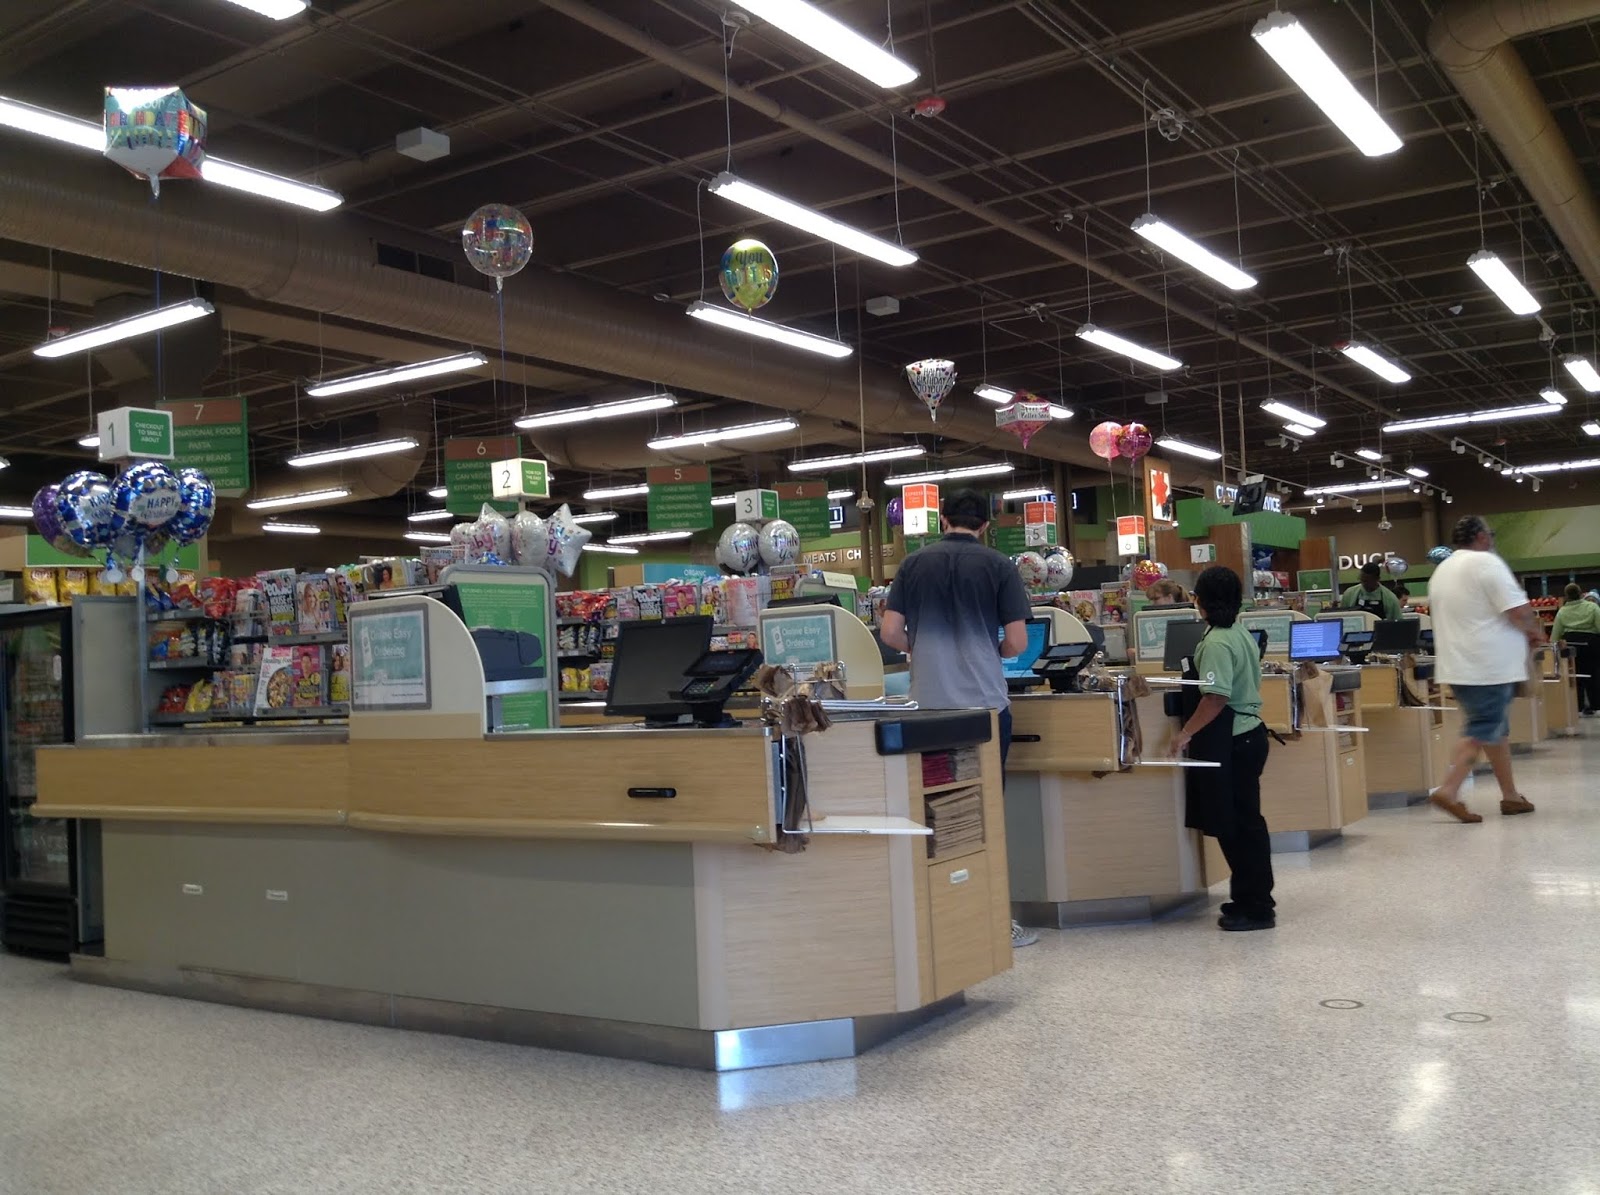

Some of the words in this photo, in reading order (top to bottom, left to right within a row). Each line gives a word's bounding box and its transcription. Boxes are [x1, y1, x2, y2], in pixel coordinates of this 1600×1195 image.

[194, 404, 204, 420] 7
[135, 422, 165, 430] CHECKOUT
[215, 427, 241, 435] FOODS
[108, 422, 115, 446] 1
[477, 442, 487, 455] 6
[205, 453, 231, 462] BEANS
[502, 469, 511, 489] 2
[674, 468, 682, 480] 5
[796, 486, 803, 497] 4
[147, 496, 175, 509] HAPPY
[745, 499, 753, 514] 3
[1016, 516, 1022, 525] 2
[1033, 528, 1040, 541] 5
[803, 551, 837, 564] MEATS
[1197, 548, 1203, 560] 7
